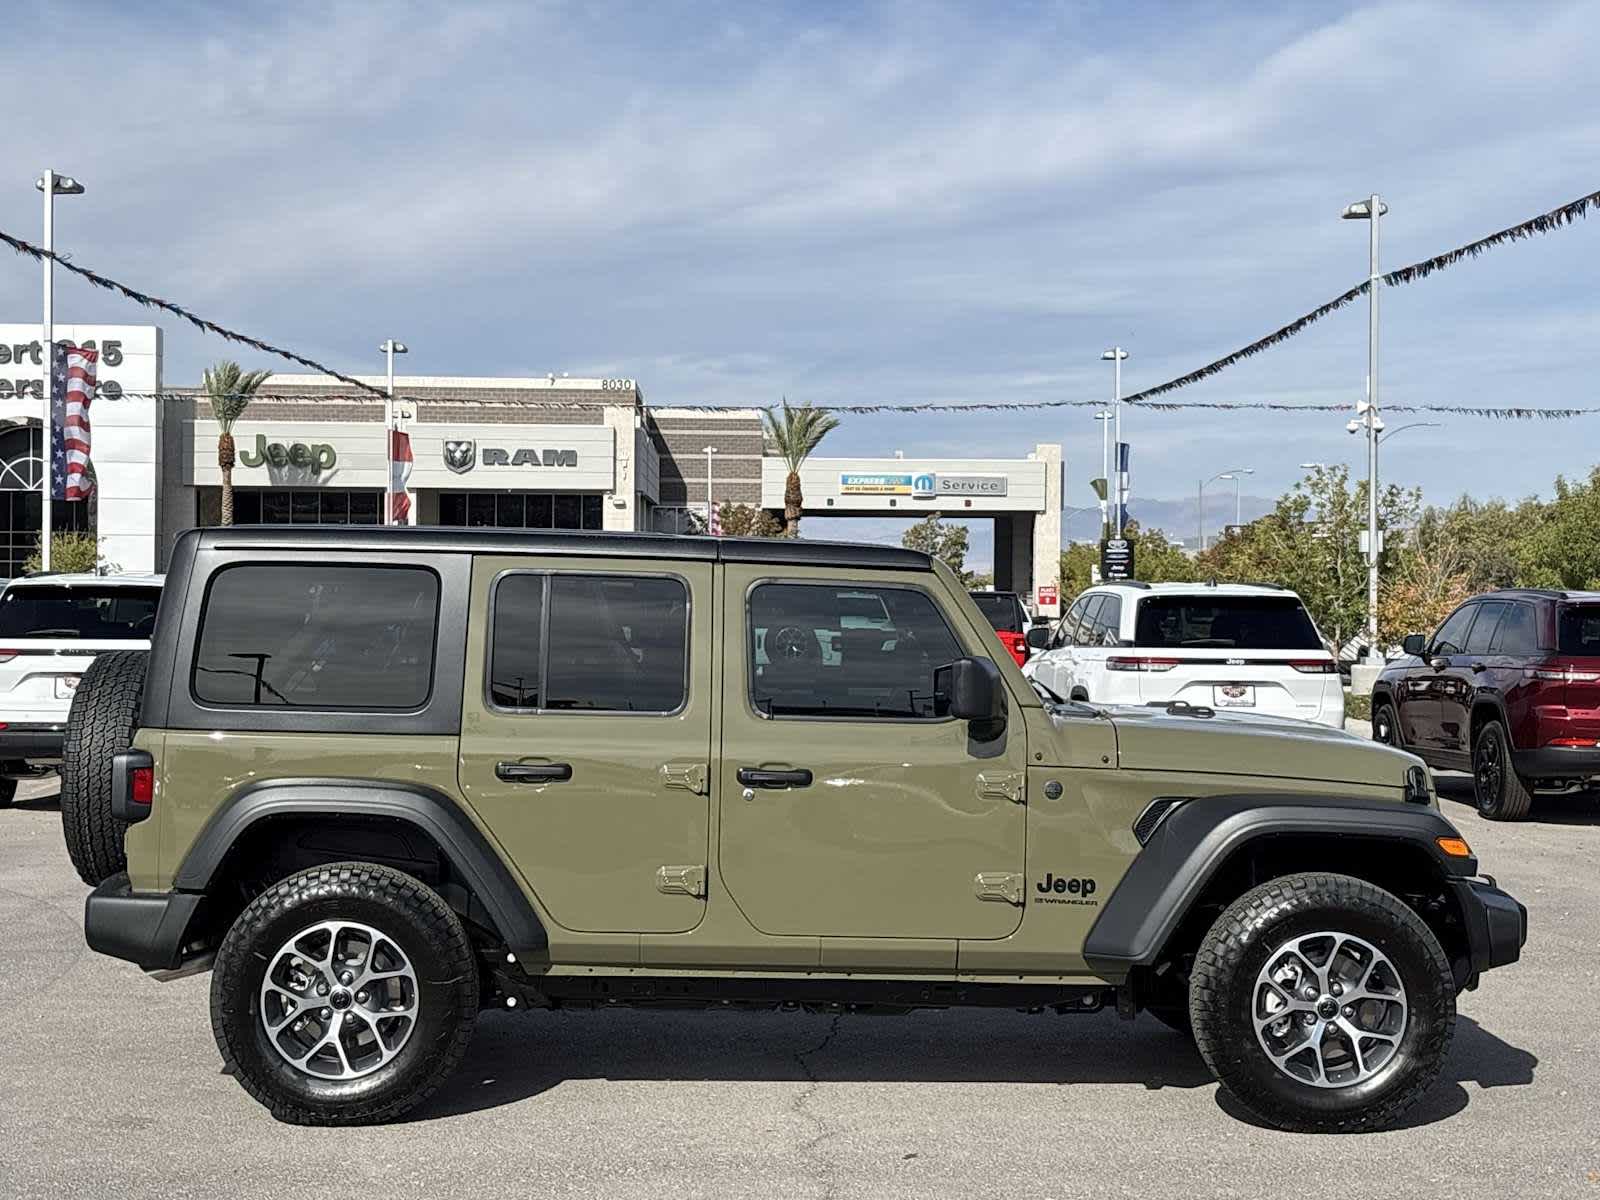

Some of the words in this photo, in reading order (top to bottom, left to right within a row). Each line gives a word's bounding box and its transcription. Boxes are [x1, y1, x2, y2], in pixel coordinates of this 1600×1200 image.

[602, 379, 631, 390] 8030
[240, 434, 336, 475] Jeep
[482, 448, 577, 467] RAM
[942, 480, 998, 491] Service
[1037, 873, 1096, 897] Jeep
[1044, 898, 1098, 906] WRANGLER
